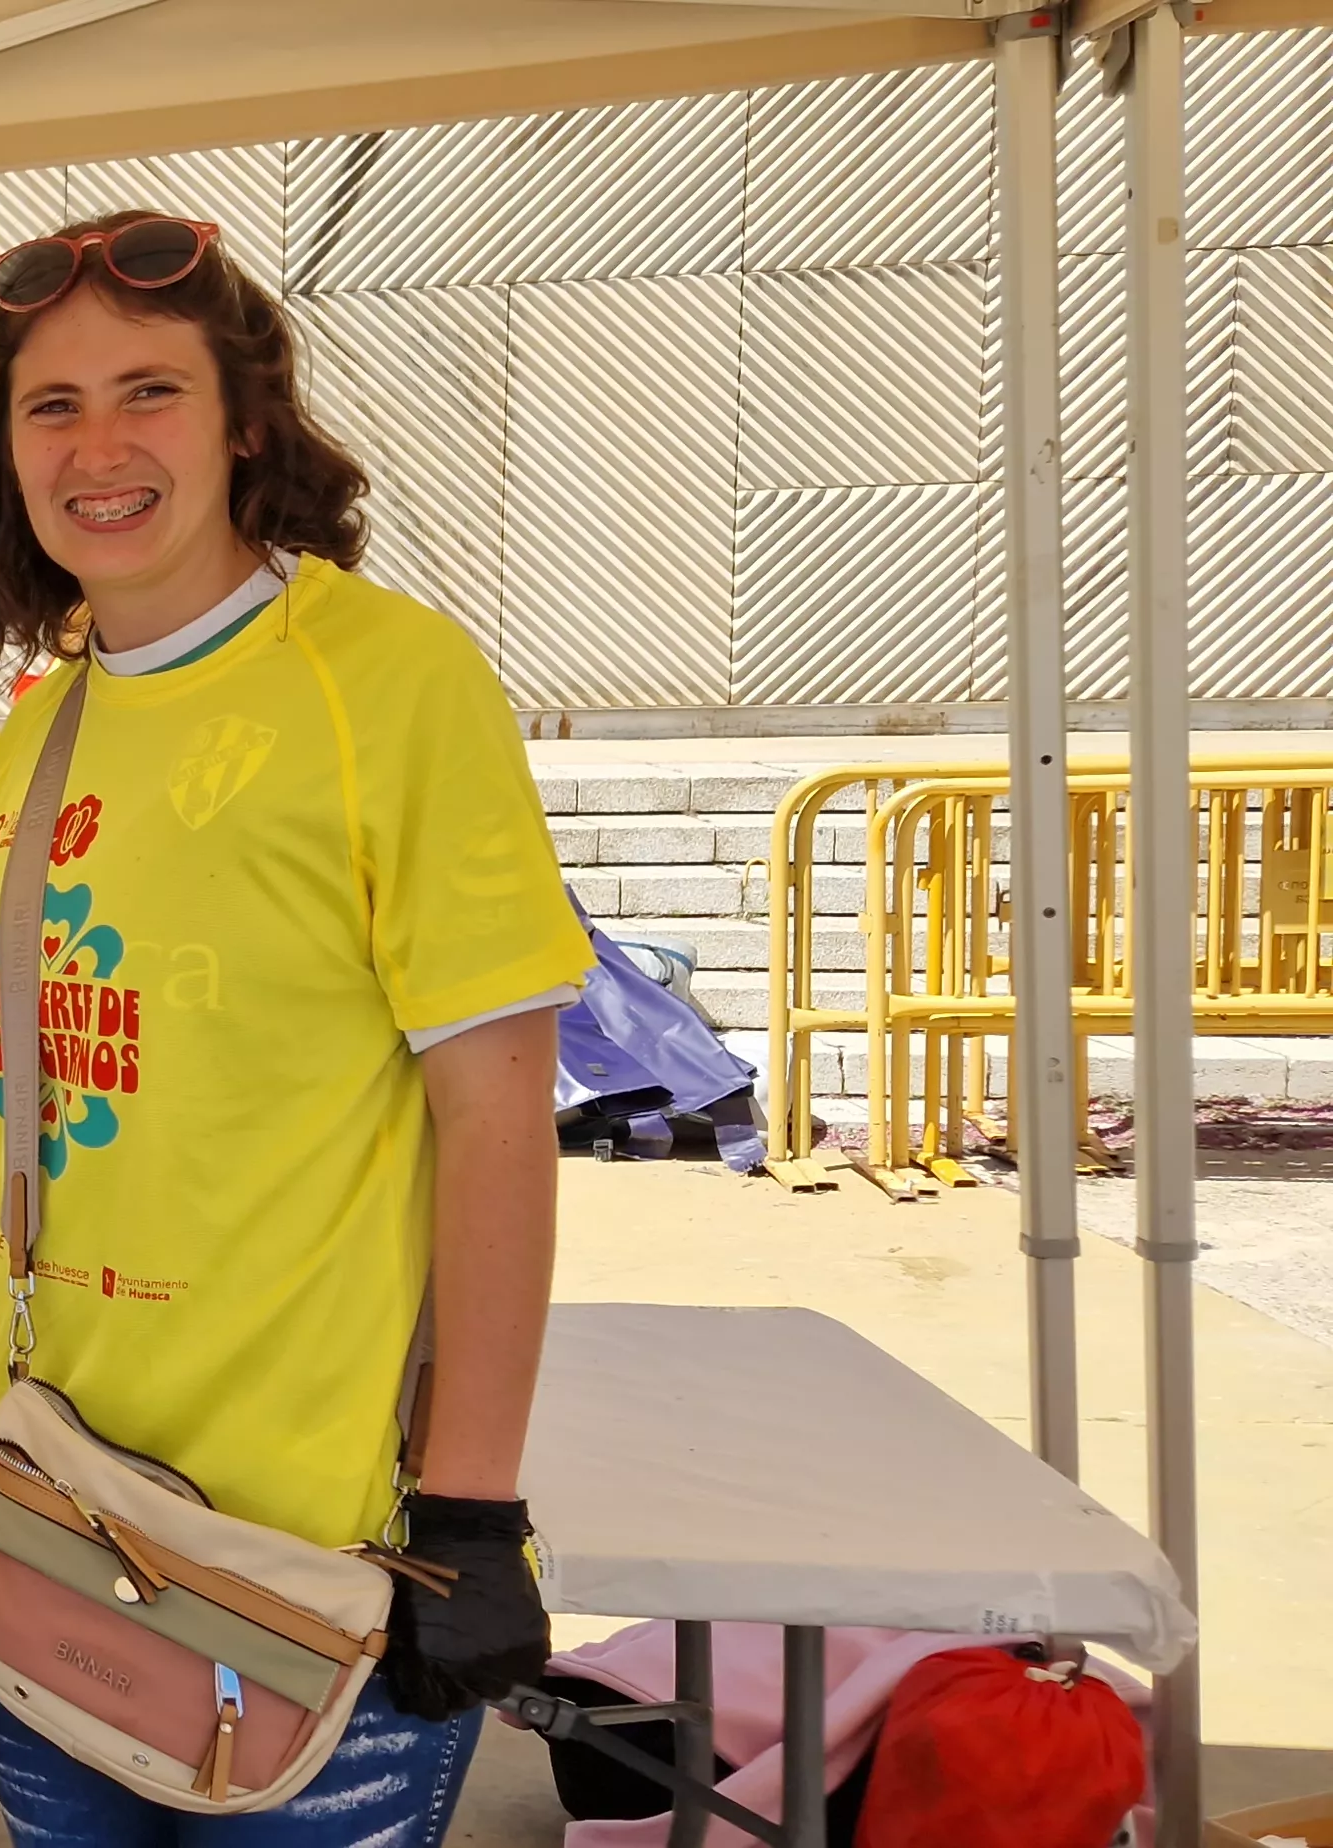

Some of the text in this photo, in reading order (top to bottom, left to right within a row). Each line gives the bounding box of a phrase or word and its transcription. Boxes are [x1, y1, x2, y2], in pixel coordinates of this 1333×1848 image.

[97, 986, 140, 1041] DE
[37, 1259, 90, 1280] de huesca
[117, 1272, 189, 1290] Ayuntamiento
[128, 1287, 170, 1301] Huesca
